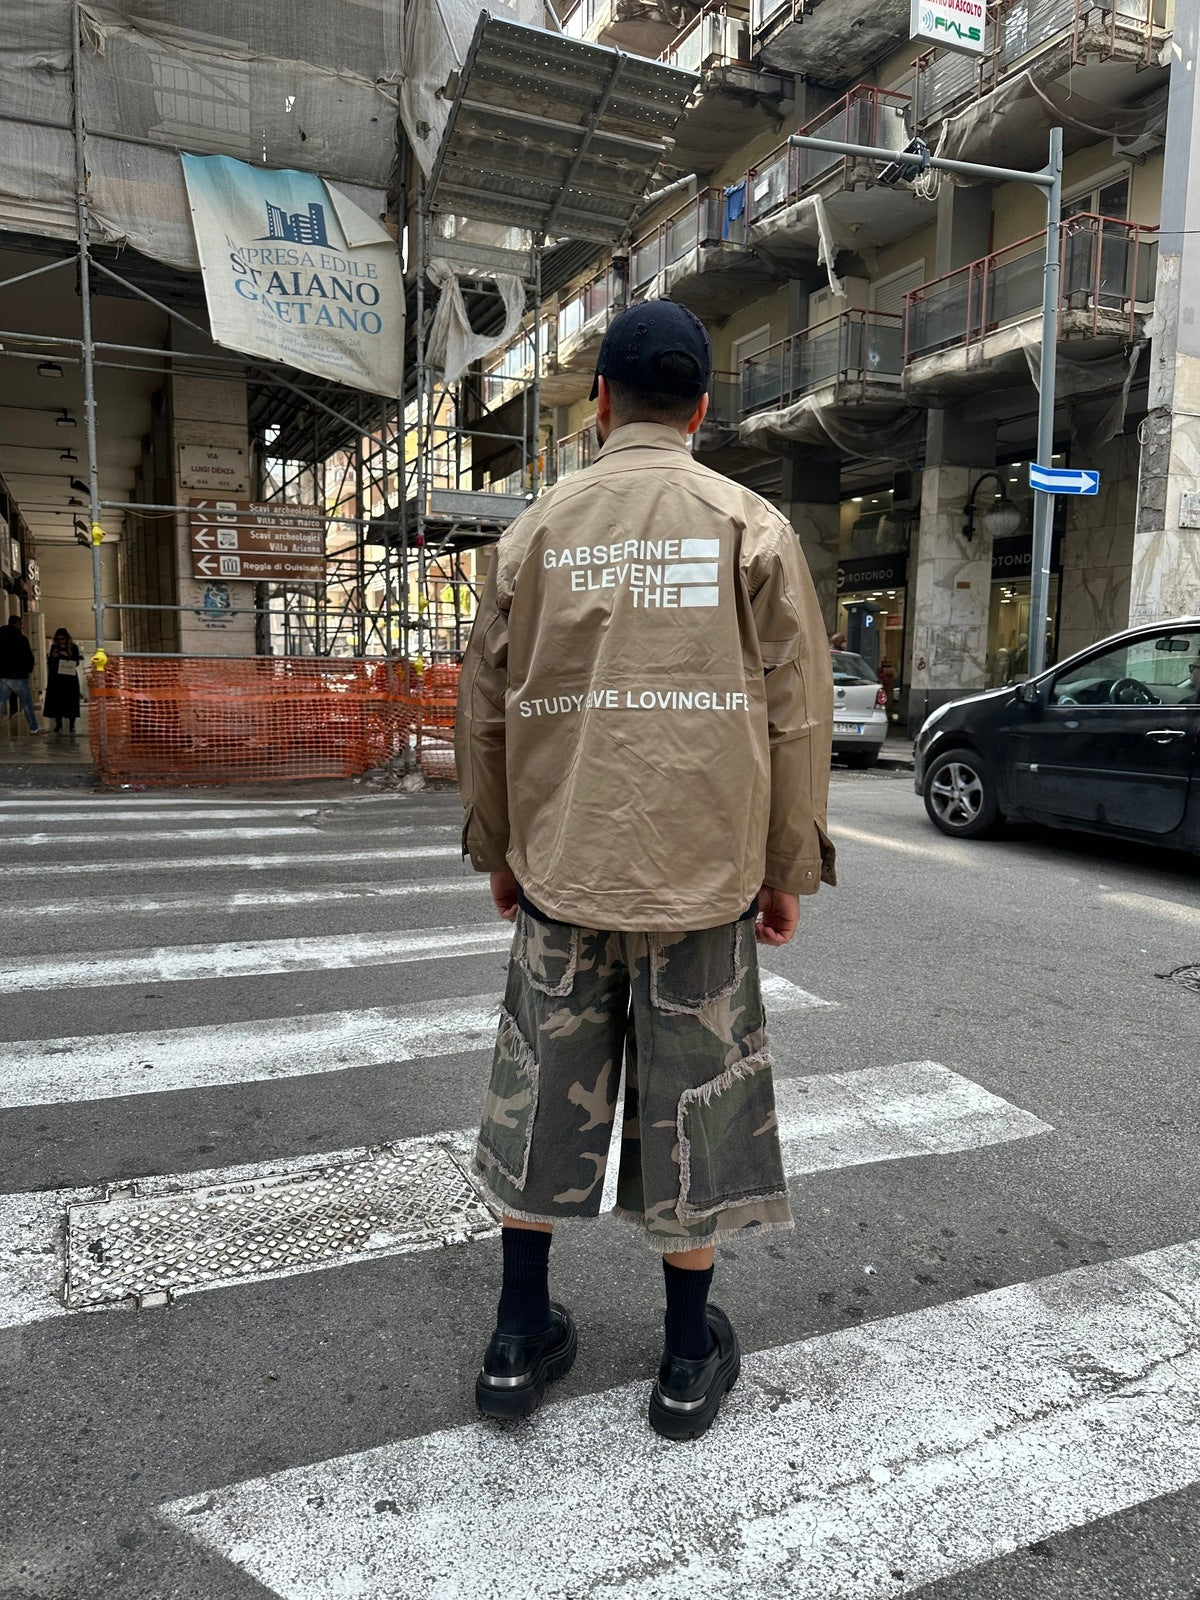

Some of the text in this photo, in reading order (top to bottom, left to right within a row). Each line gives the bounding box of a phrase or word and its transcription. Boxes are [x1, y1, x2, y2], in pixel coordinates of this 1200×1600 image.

[955, 0, 982, 17] ASCOLTO
[320, 253, 378, 279] EDILE
[230, 252, 380, 306] STAIANO
[191, 465, 235, 475] LUIGI DENZA
[249, 503, 319, 516] Scavi archeologici
[257, 516, 320, 528] Villa San Marco
[250, 530, 320, 543] Scavi archeologici
[269, 542, 320, 553] Villa Arianna
[543, 538, 680, 569] GABSERINE
[243, 562, 324, 572] Reggia di Quisisana
[571, 563, 663, 592] ELEVEN
[836, 568, 894, 588] GIROTONDO
[629, 586, 678, 608] THE
[865, 615, 874, 628] P
[519, 694, 584, 718] STUDY
